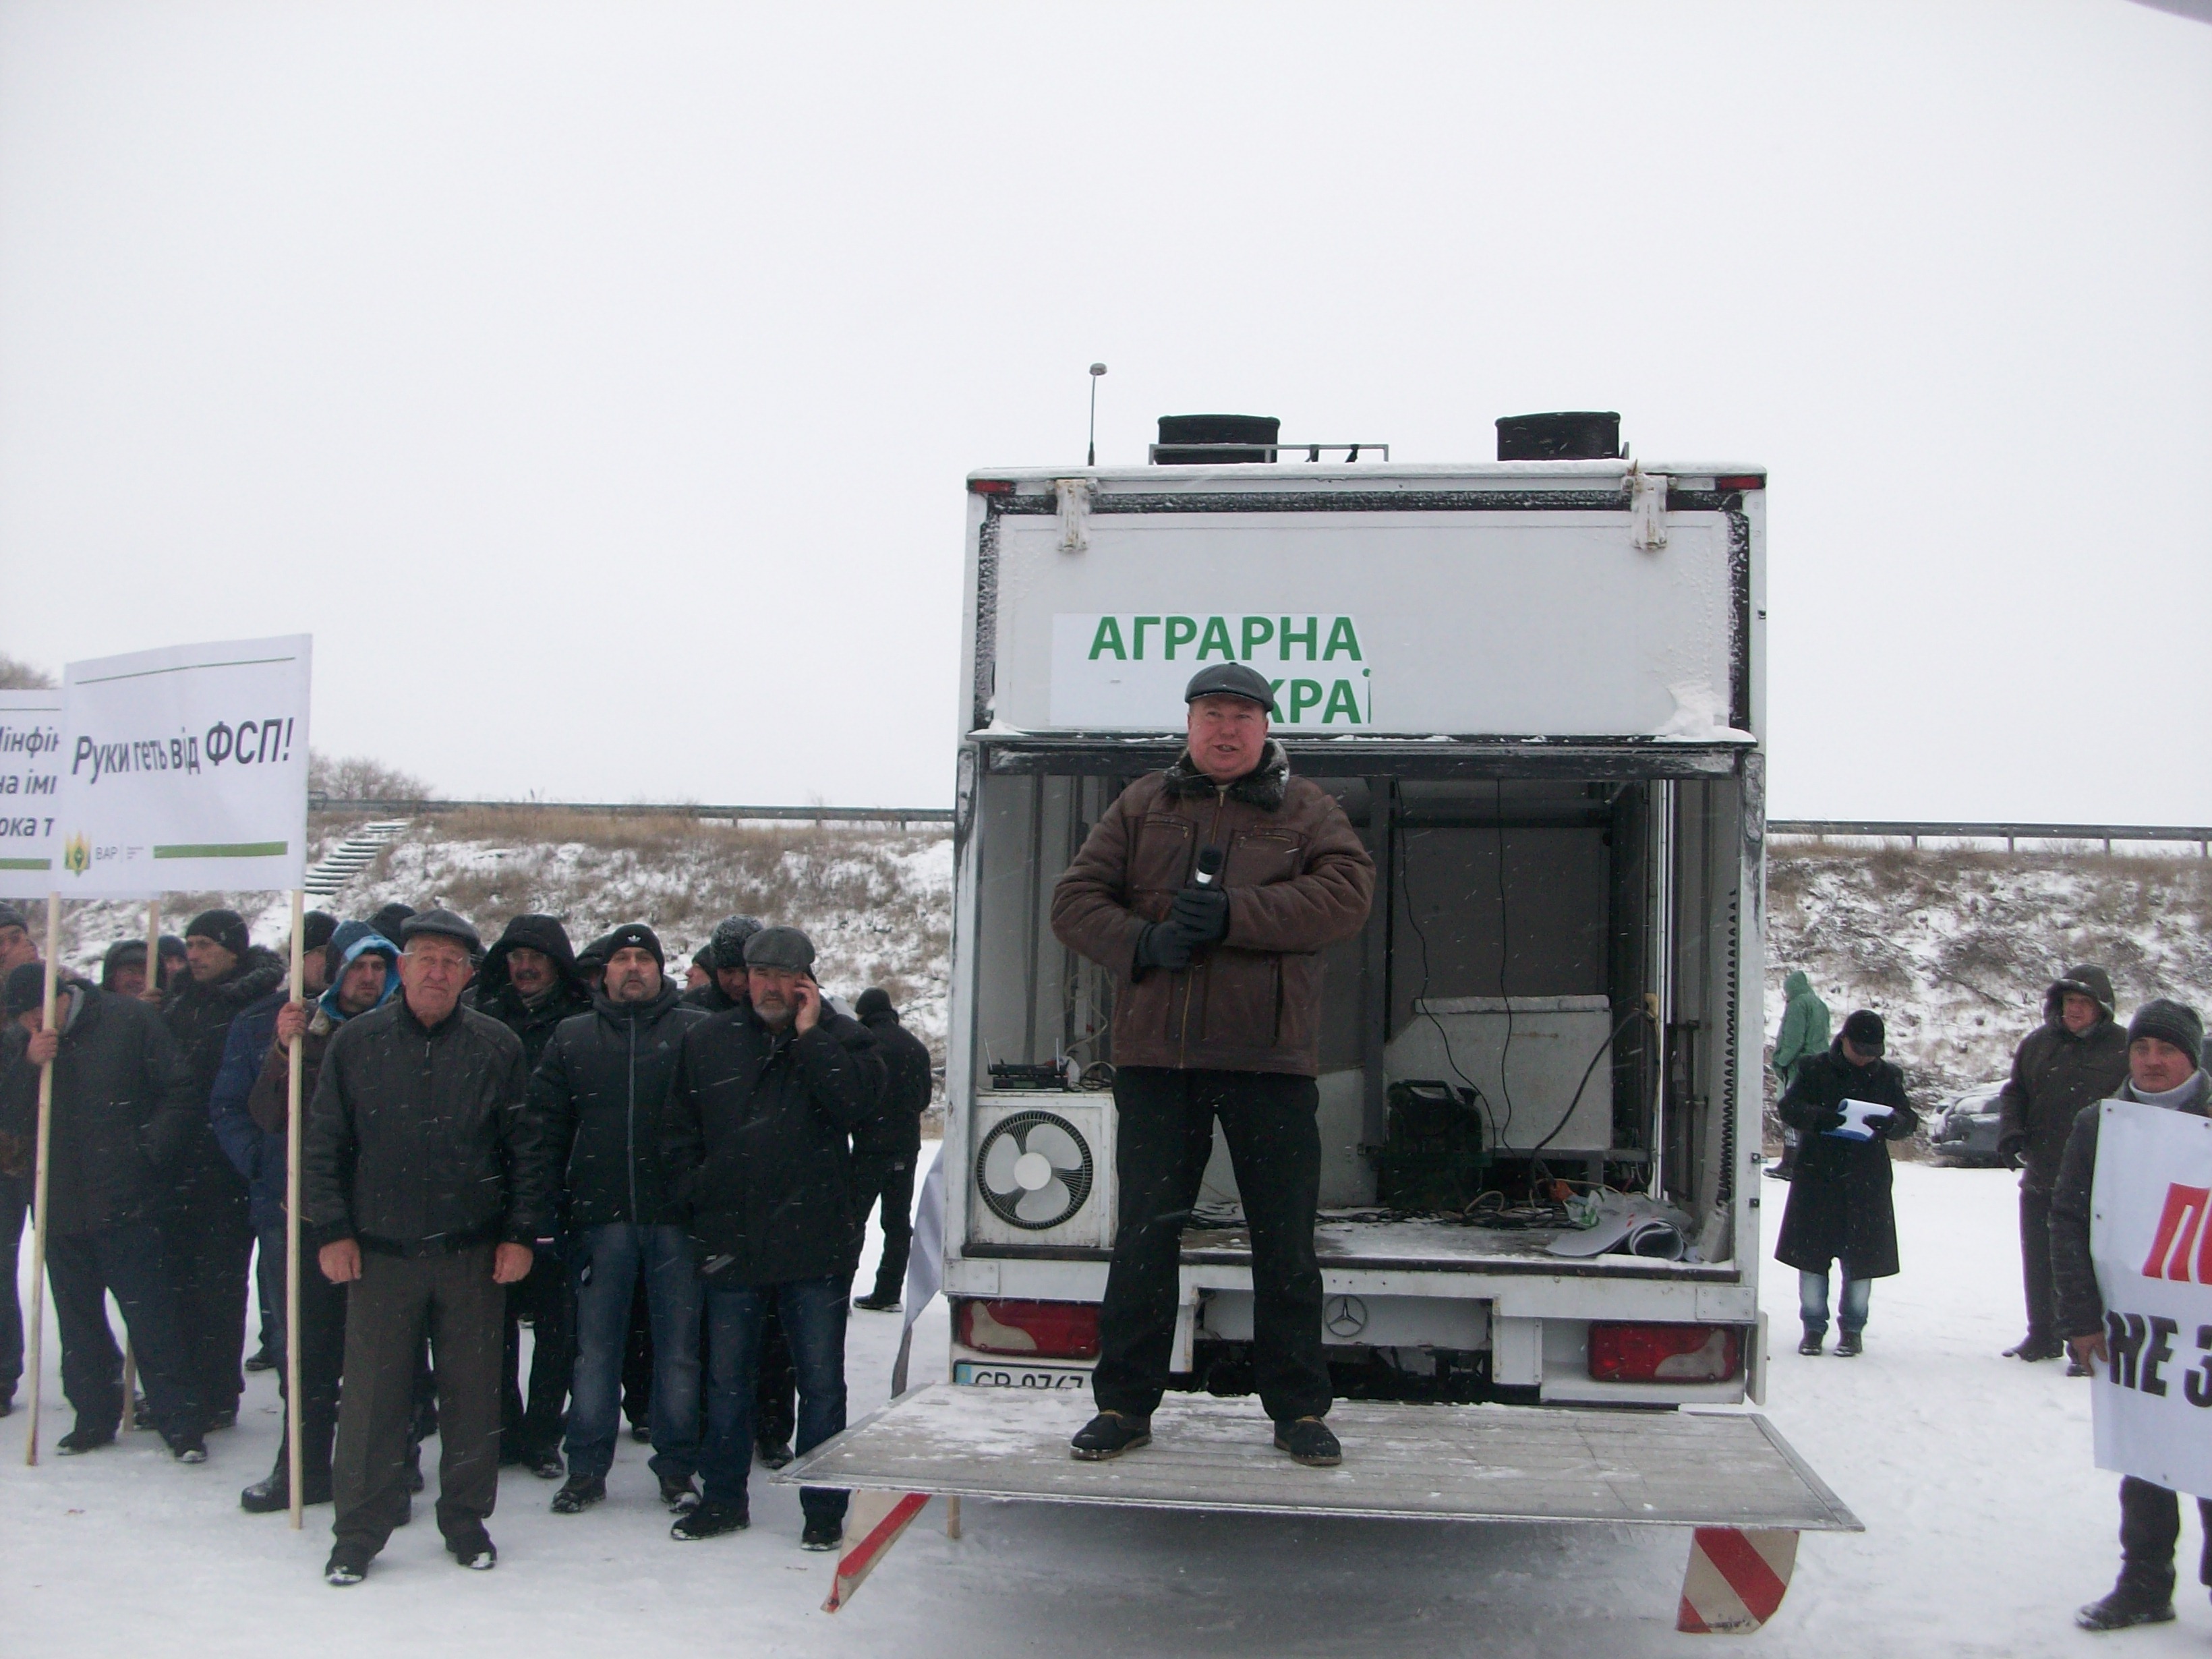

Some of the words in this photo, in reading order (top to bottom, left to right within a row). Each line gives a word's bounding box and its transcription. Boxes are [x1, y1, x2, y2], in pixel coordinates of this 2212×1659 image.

[1088, 616, 1363, 662] АГРАРНА
[72, 736, 130, 784] Руки
[134, 740, 168, 772] геть
[171, 726, 201, 776] від
[206, 717, 295, 766] ФСП!
[2105, 1310, 2179, 1397] НЕ
